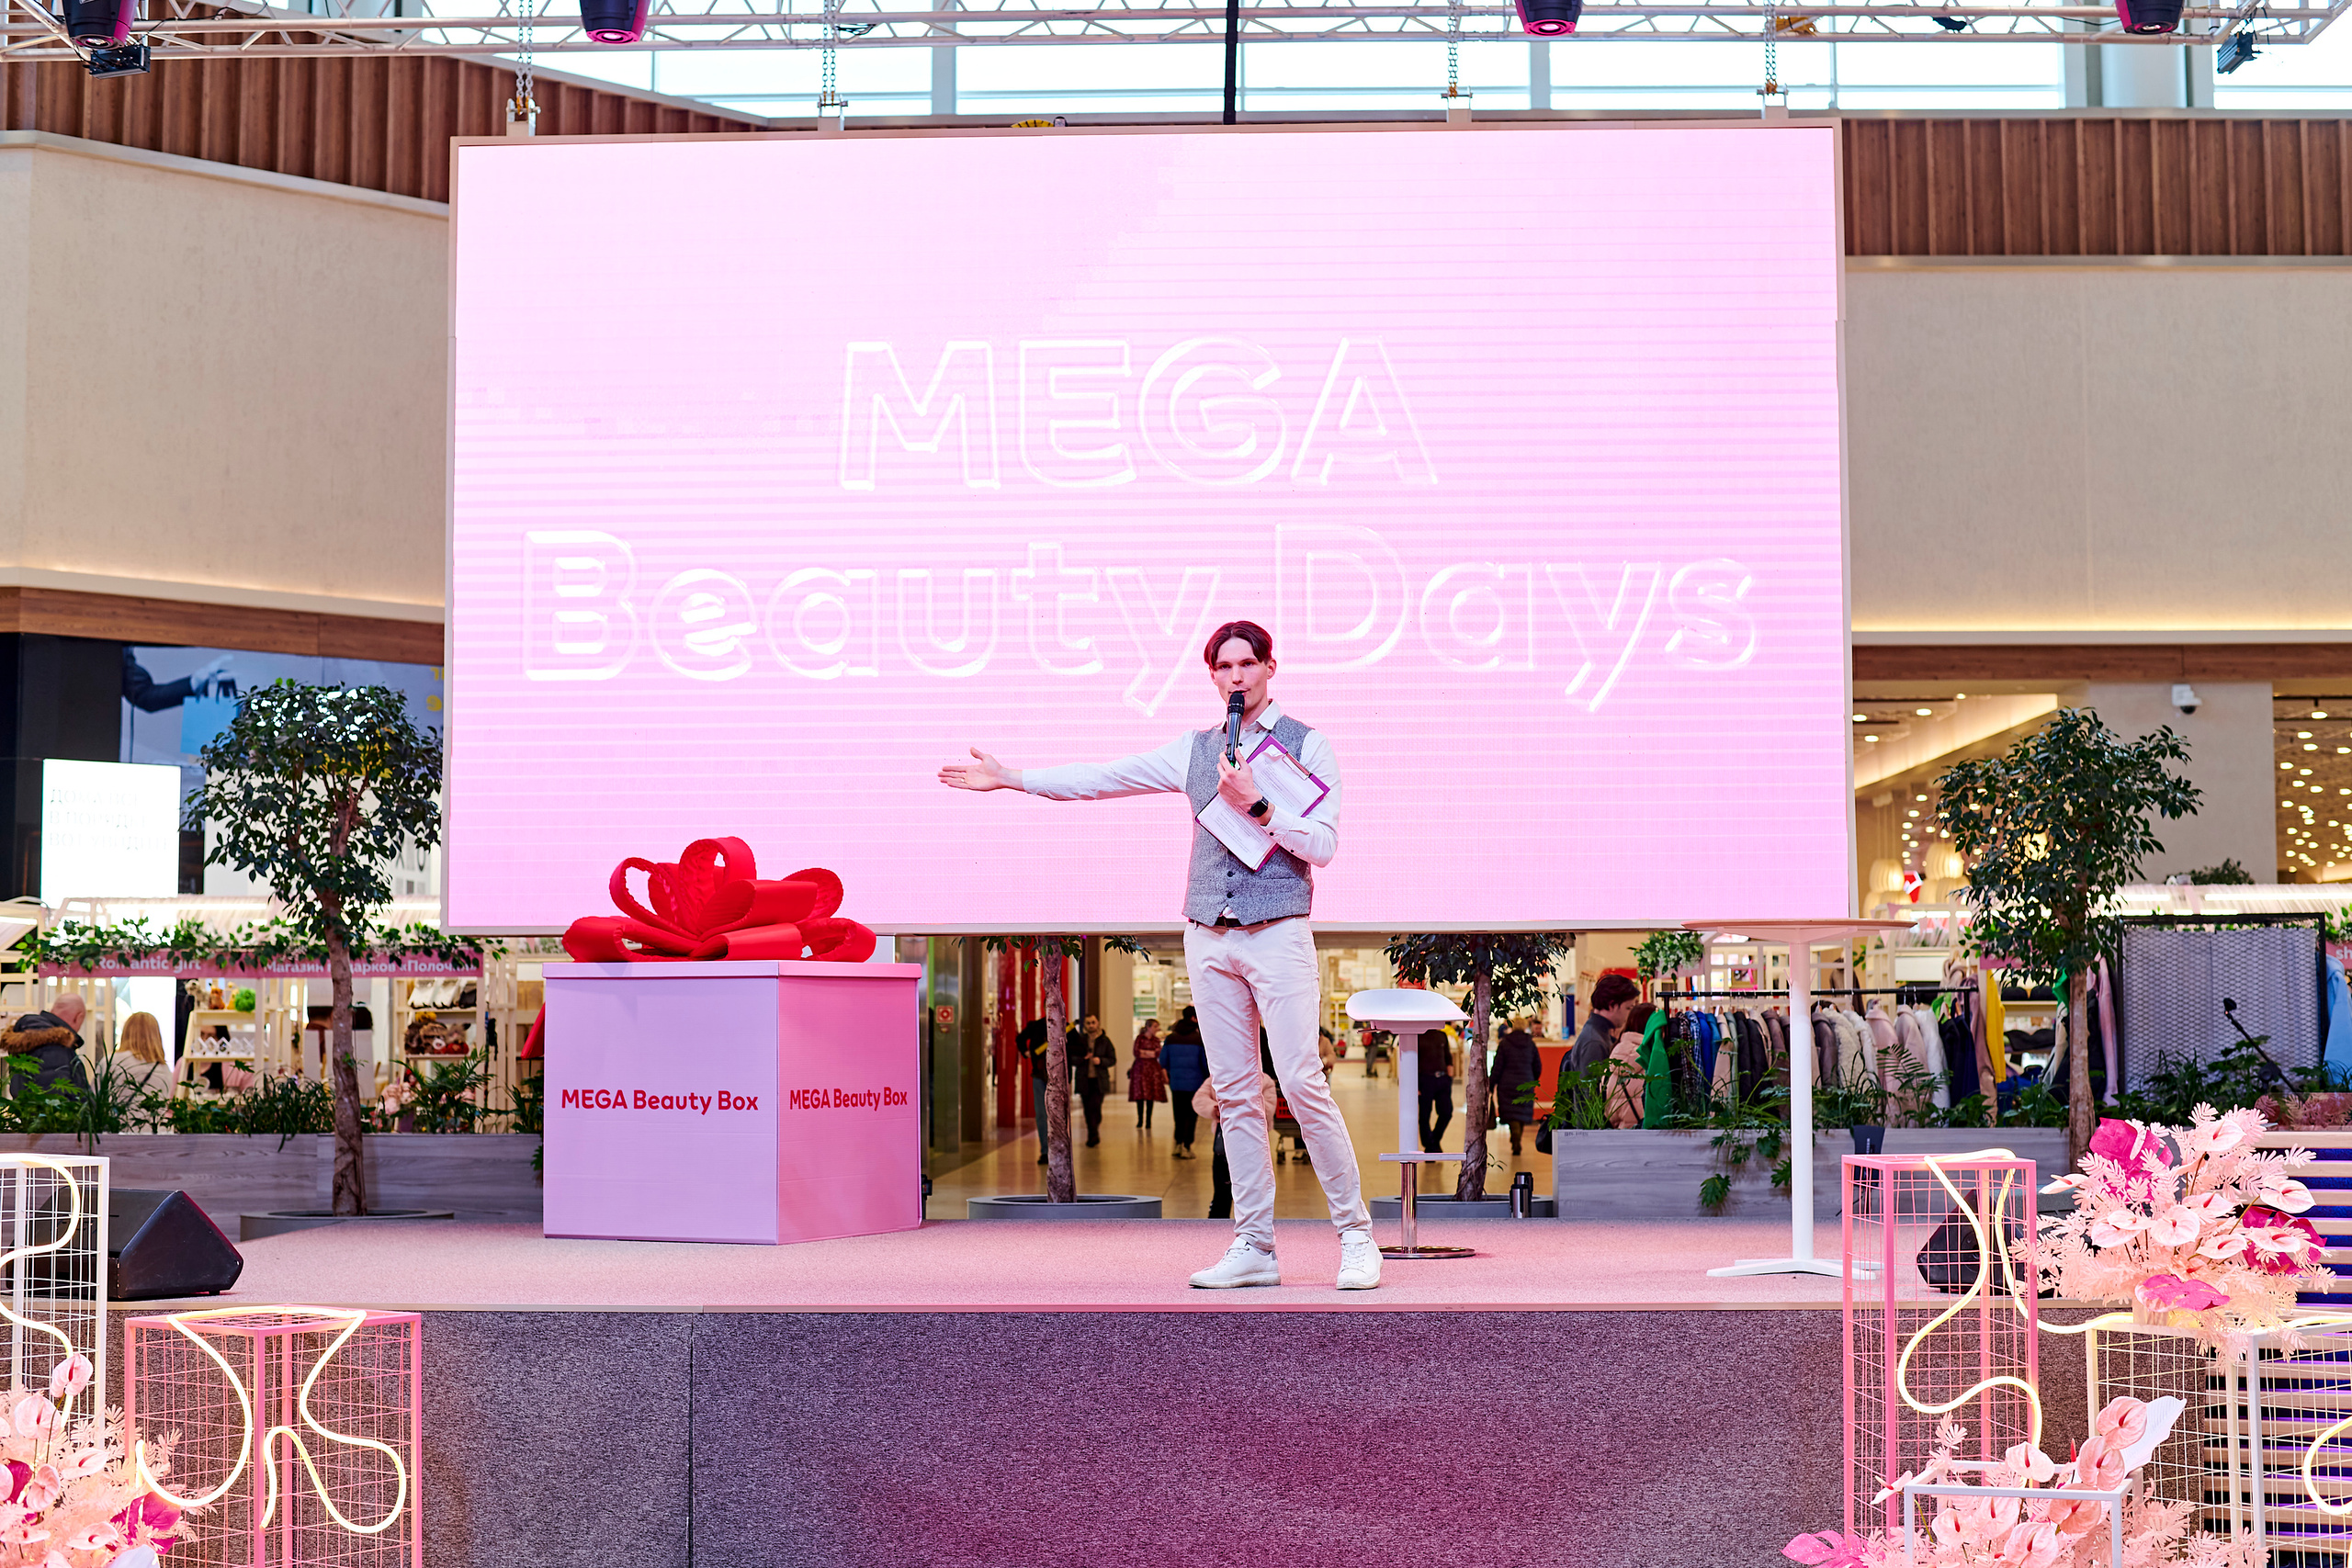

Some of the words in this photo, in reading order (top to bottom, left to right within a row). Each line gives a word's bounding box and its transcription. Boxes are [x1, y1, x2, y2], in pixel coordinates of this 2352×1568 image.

[838, 336, 1439, 491] MEGA
[522, 529, 1222, 717] Beauty
[1272, 522, 1760, 713] Days
[97, 955, 169, 970] Roantic
[327, 962, 396, 976] арков
[561, 1089, 628, 1110] MEGA
[633, 1089, 712, 1115] Beauty
[718, 1090, 759, 1111] Box
[789, 1089, 831, 1110] MEGA
[833, 1088, 881, 1111] Beauty
[884, 1087, 908, 1106] Box
